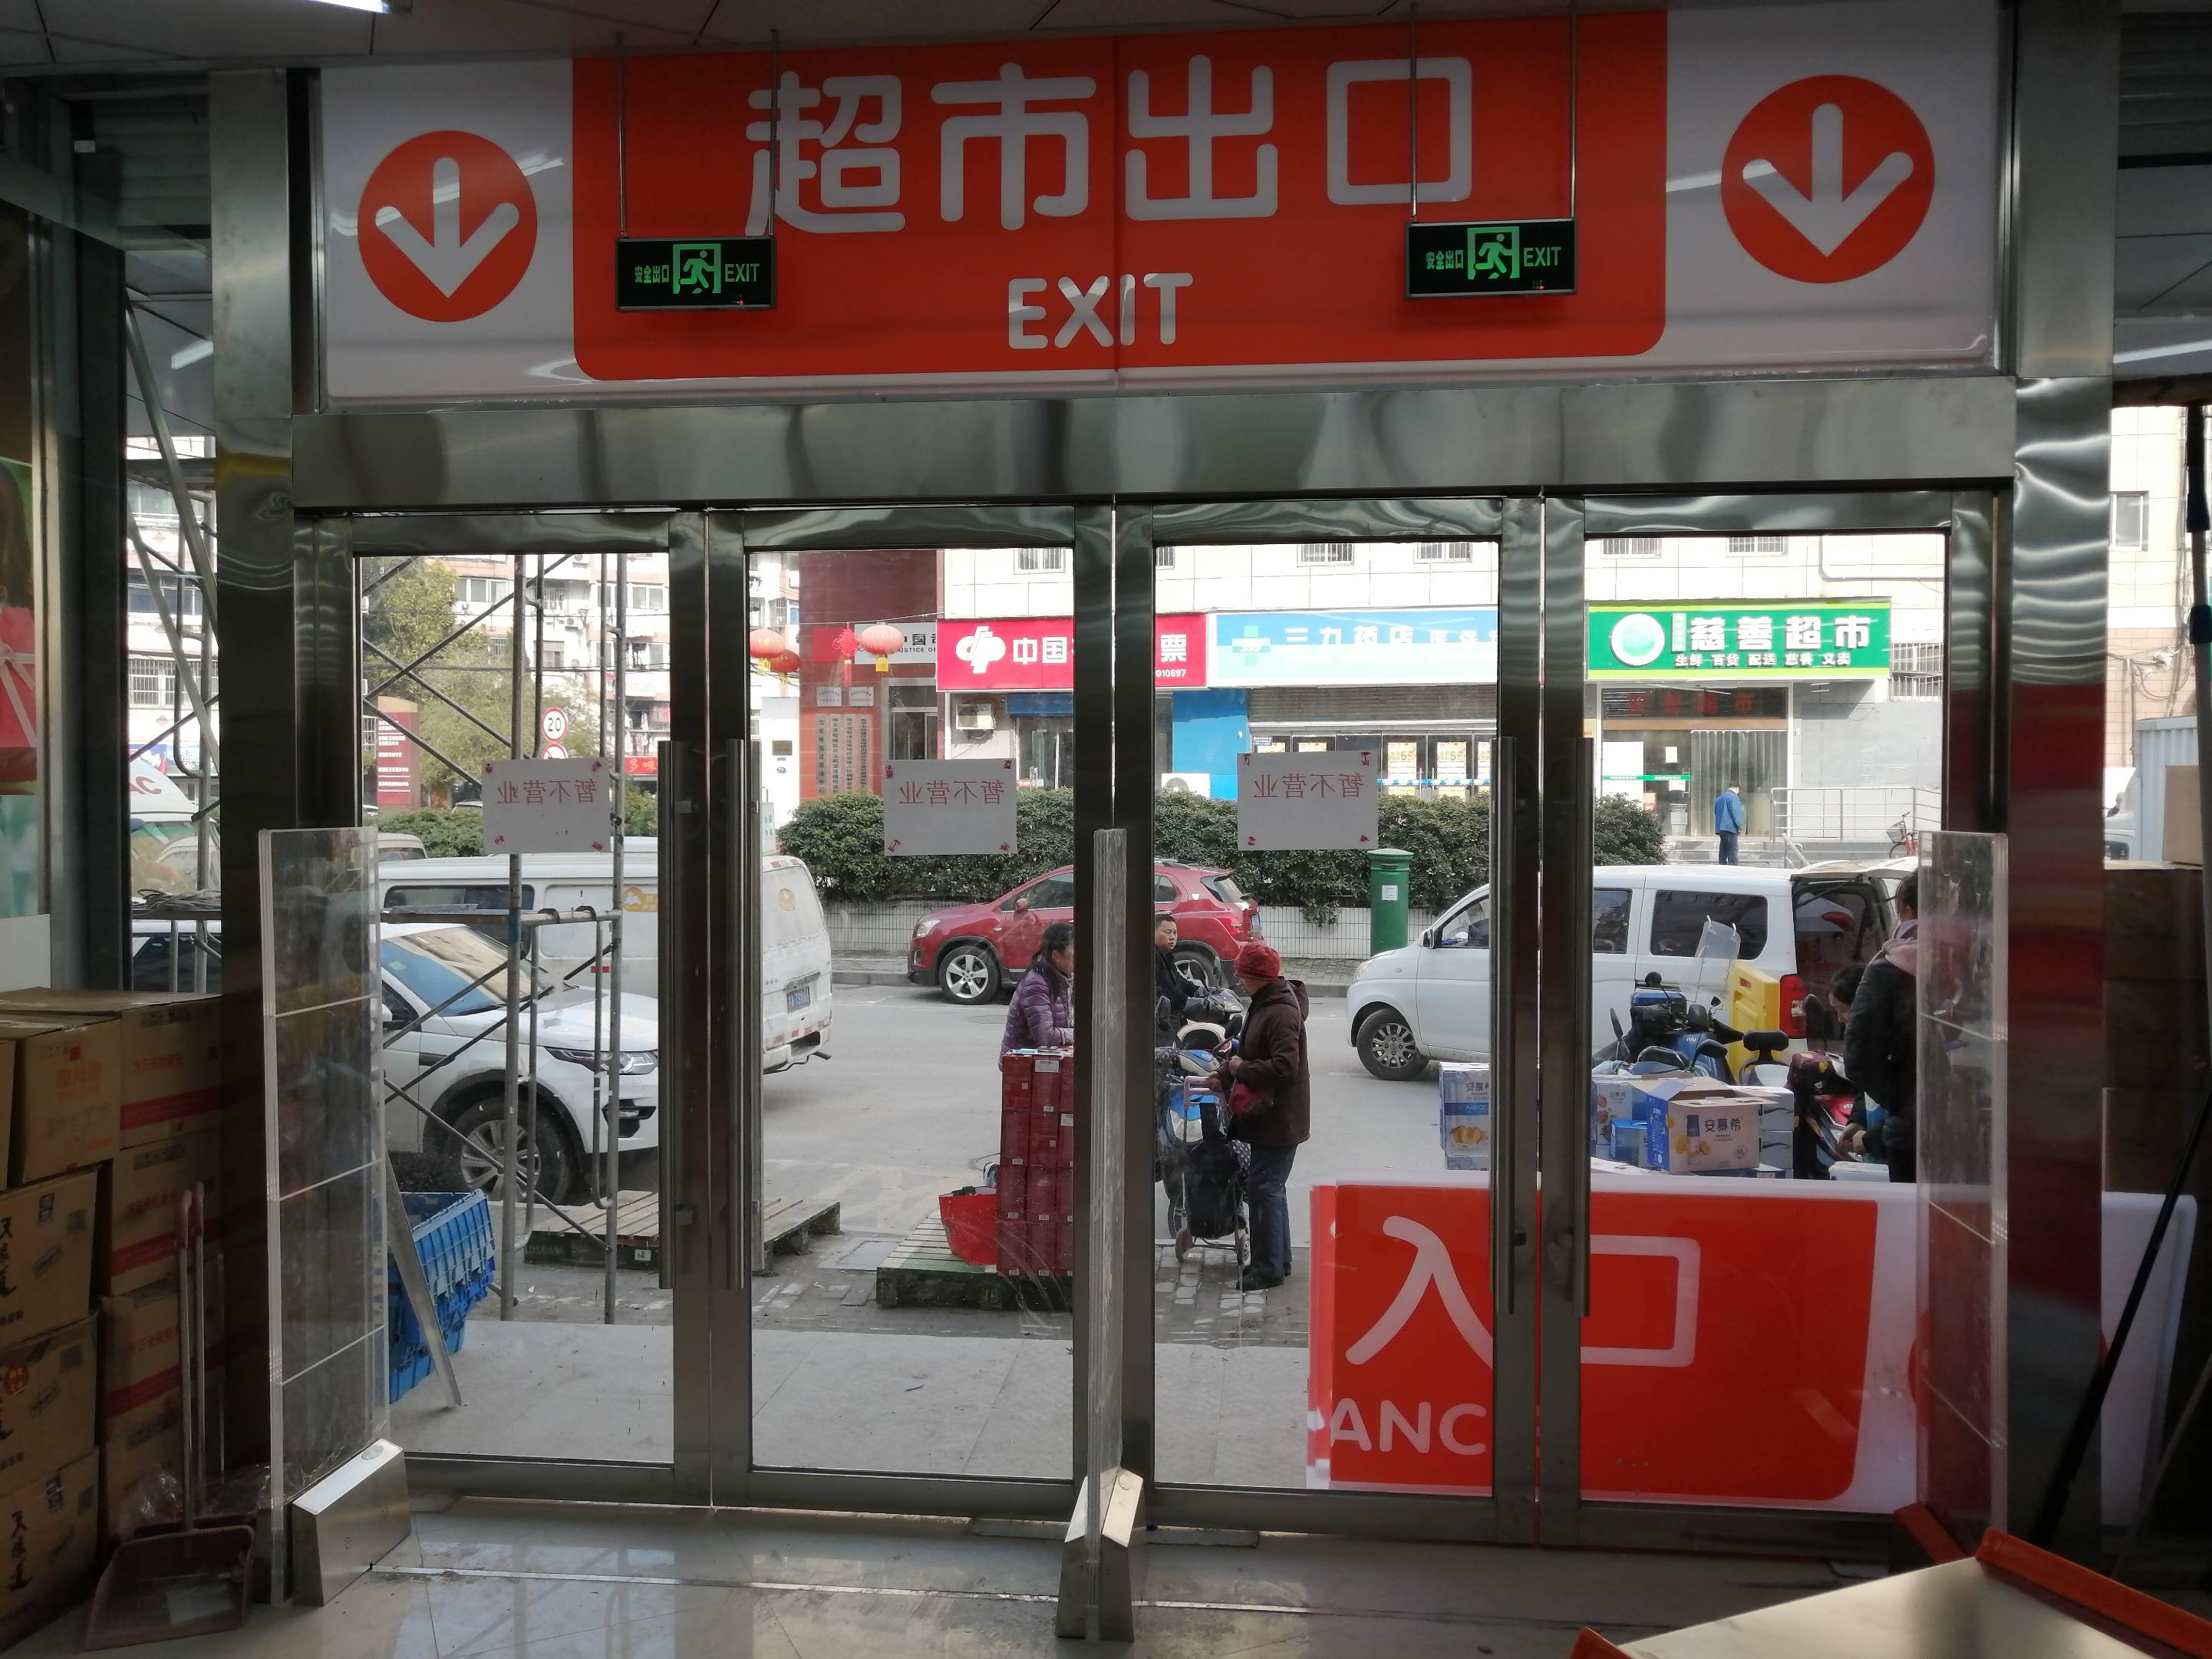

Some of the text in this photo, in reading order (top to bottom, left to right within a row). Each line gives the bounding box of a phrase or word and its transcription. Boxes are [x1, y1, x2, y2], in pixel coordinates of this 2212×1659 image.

[744, 54, 1472, 236] 超市出口
[1425, 249, 1465, 272] 安全出口
[1522, 246, 1561, 268] EXIT
[635, 265, 670, 283] 安全出口
[724, 263, 760, 282] EXIT
[1007, 272, 1194, 351] EXIT
[1690, 615, 1871, 651] 慈善超市
[1155, 668, 1187, 678] 010697
[547, 717, 562, 732] 20
[1704, 1116, 1742, 1133] 安慕希
[1346, 1215, 1700, 1368] 入口
[1330, 1397, 1488, 1456] ANC
